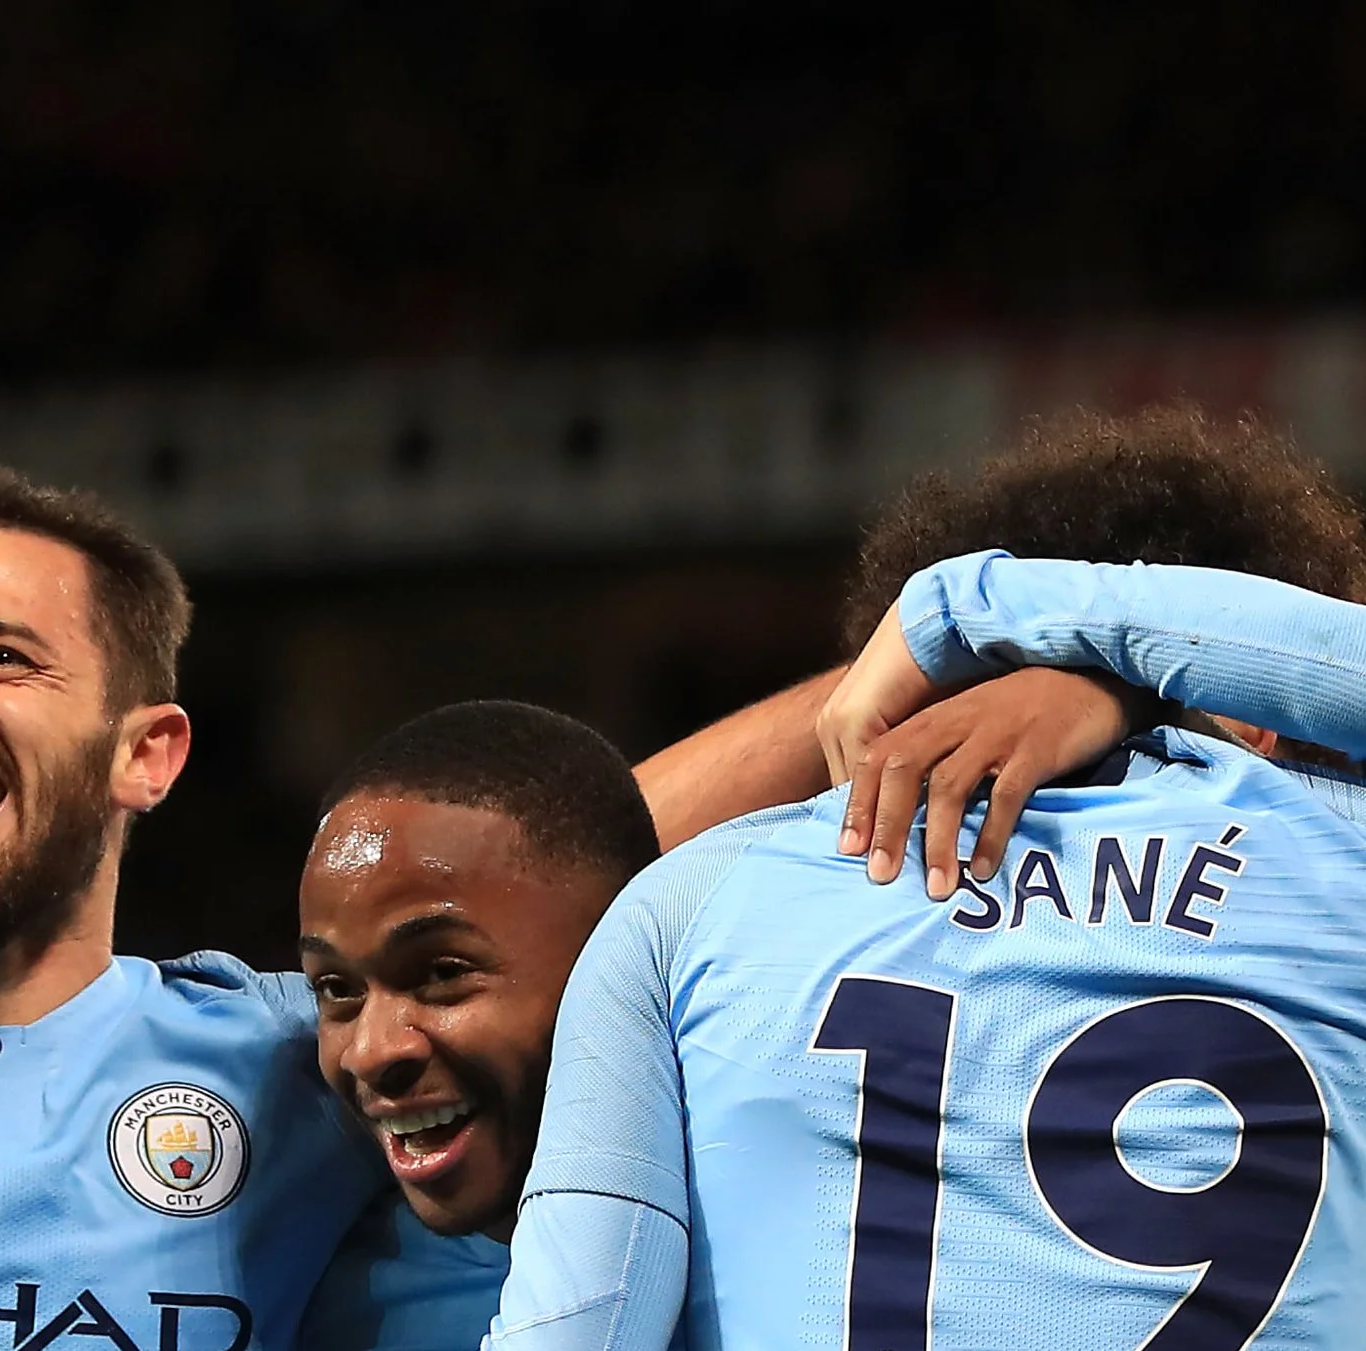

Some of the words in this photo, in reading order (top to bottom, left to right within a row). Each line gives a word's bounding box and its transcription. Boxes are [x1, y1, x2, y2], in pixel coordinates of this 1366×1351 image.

[949, 822, 1249, 941] SANÉ
[123, 1092, 233, 1131] MANCHESTER
[166, 1194, 203, 1207] CITY
